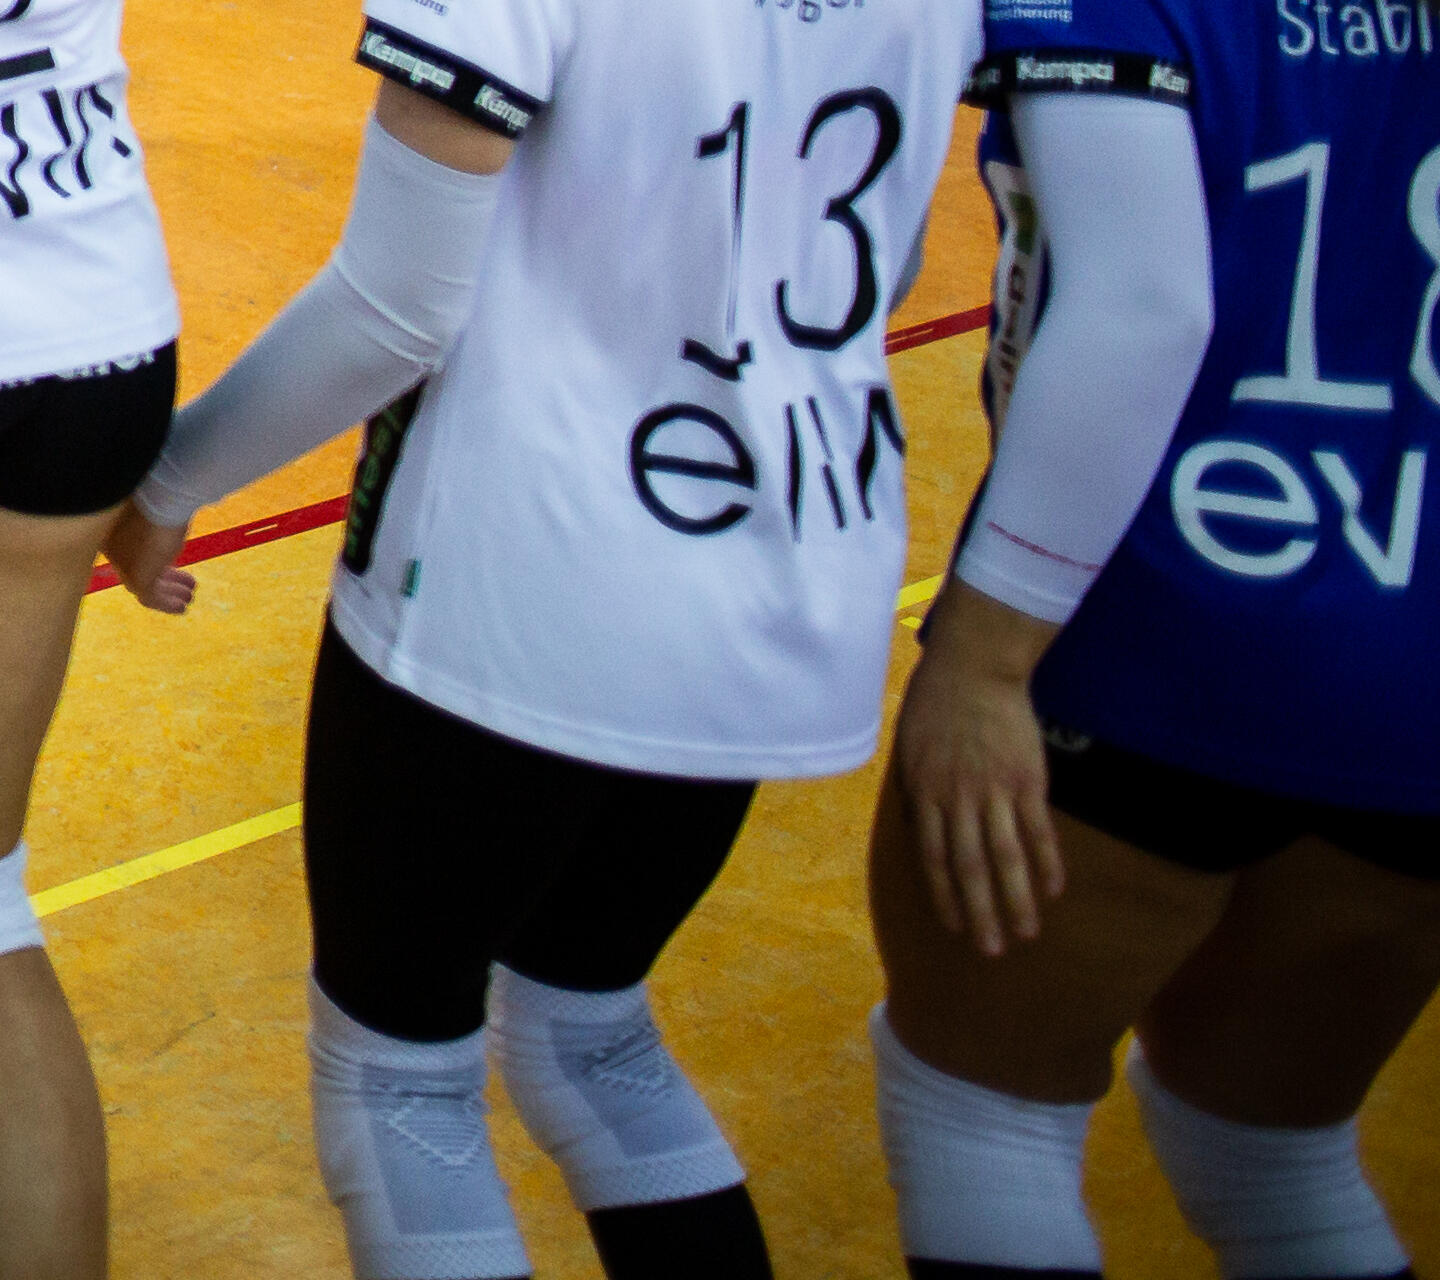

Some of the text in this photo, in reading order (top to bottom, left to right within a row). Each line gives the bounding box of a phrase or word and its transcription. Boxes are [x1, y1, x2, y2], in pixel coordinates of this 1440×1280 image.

[361, 34, 457, 92] Kempa
[1015, 56, 1115, 86] Kempa
[680, 87, 902, 382] 13
